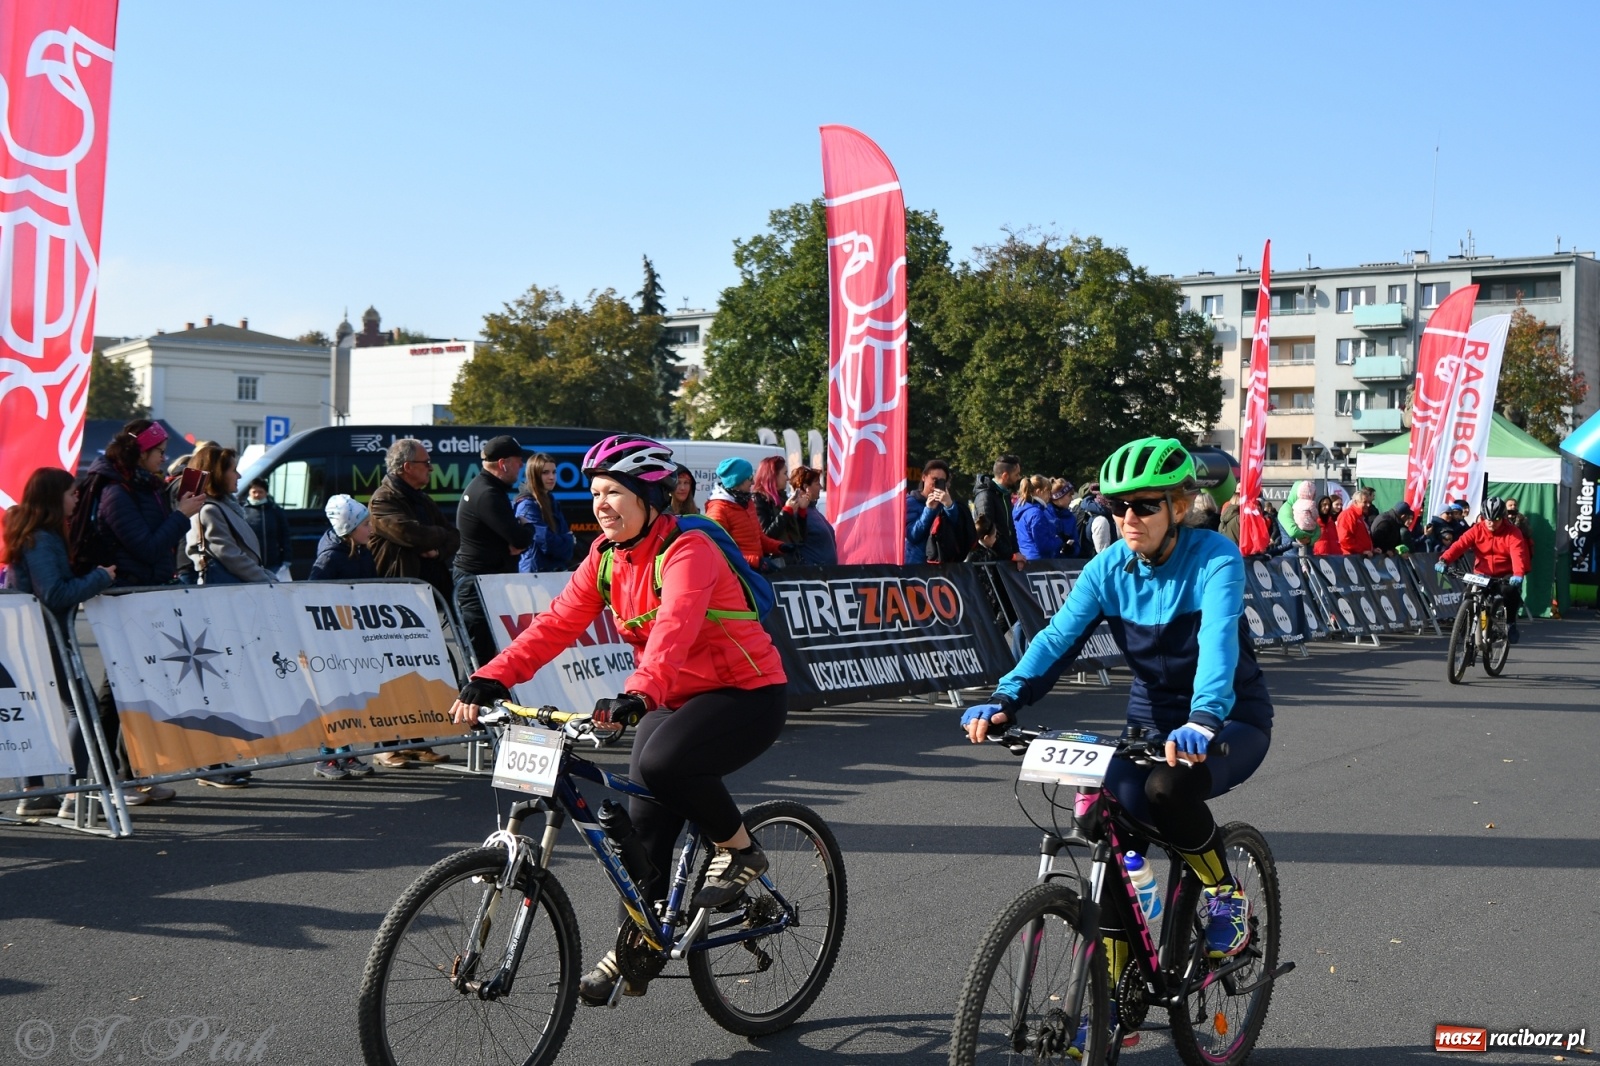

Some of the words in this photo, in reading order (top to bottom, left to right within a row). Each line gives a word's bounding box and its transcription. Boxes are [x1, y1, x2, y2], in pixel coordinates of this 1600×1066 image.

[270, 420, 285, 442] P
[1445, 340, 1489, 504] RACIBÓRZ
[438, 435, 489, 453] atelie
[695, 470, 719, 481] Najp
[1262, 488, 1289, 499] MAT
[1577, 478, 1594, 533] atelier
[173, 608, 183, 617] N
[773, 578, 963, 637] TREZADO
[305, 605, 397, 630] TAURUS
[362, 633, 402, 643] gdziekolwiek
[403, 632, 429, 641] jedziesz
[144, 655, 156, 664] W
[225, 646, 233, 656] E
[562, 656, 605, 684] TAKE
[604, 651, 637, 676] MOR
[808, 655, 905, 691] USZCZELNIAMY
[904, 648, 983, 681] NAJLEPSZYCH
[203, 696, 210, 705] S
[326, 717, 366, 734] www.
[507, 750, 549, 775] 3059
[1041, 746, 1098, 767] 3179
